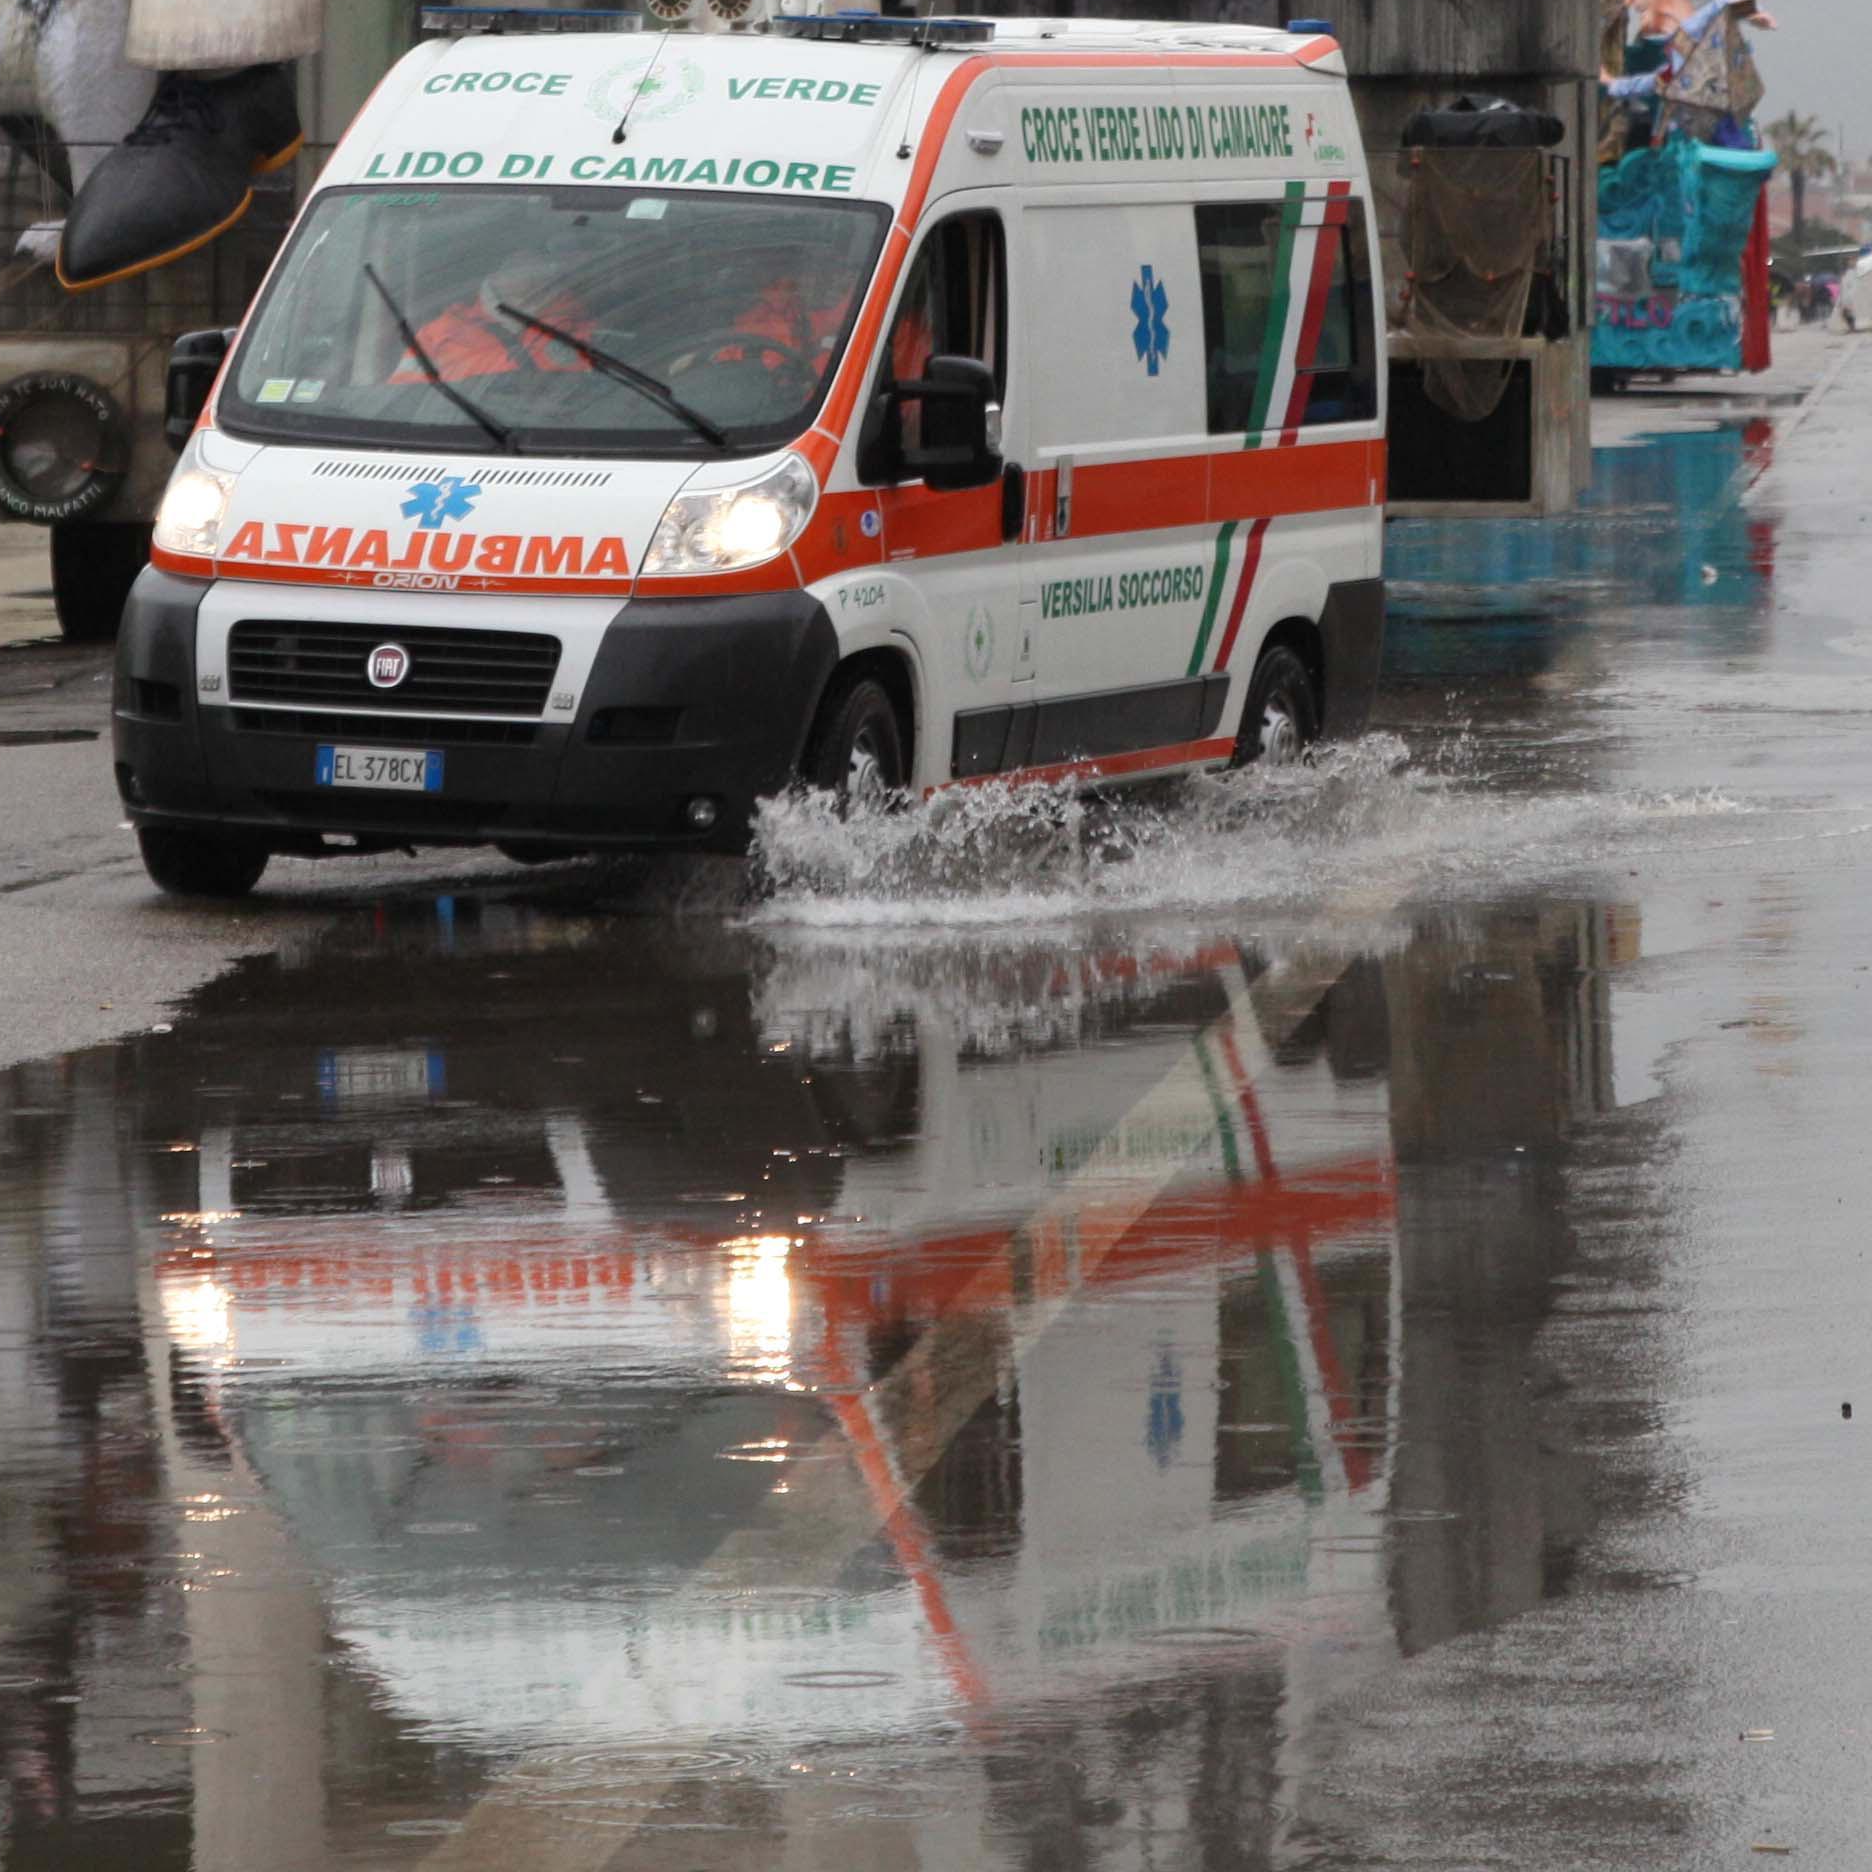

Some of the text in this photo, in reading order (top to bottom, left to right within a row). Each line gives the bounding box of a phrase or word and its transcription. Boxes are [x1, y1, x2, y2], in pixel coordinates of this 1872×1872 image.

[423, 72, 883, 106] CROCE VERDE
[1021, 105, 1293, 162] CROCE VERDE LIDO DI CAMAIORE
[364, 151, 856, 192] LIDO DI CAMAIORE
[372, 572, 460, 590] ORION
[853, 584, 885, 608] 4204
[1041, 565, 1204, 620] VERSILIA SOCCORSO
[375, 658, 401, 677] FIAT
[334, 754, 425, 783] EL 378CX
